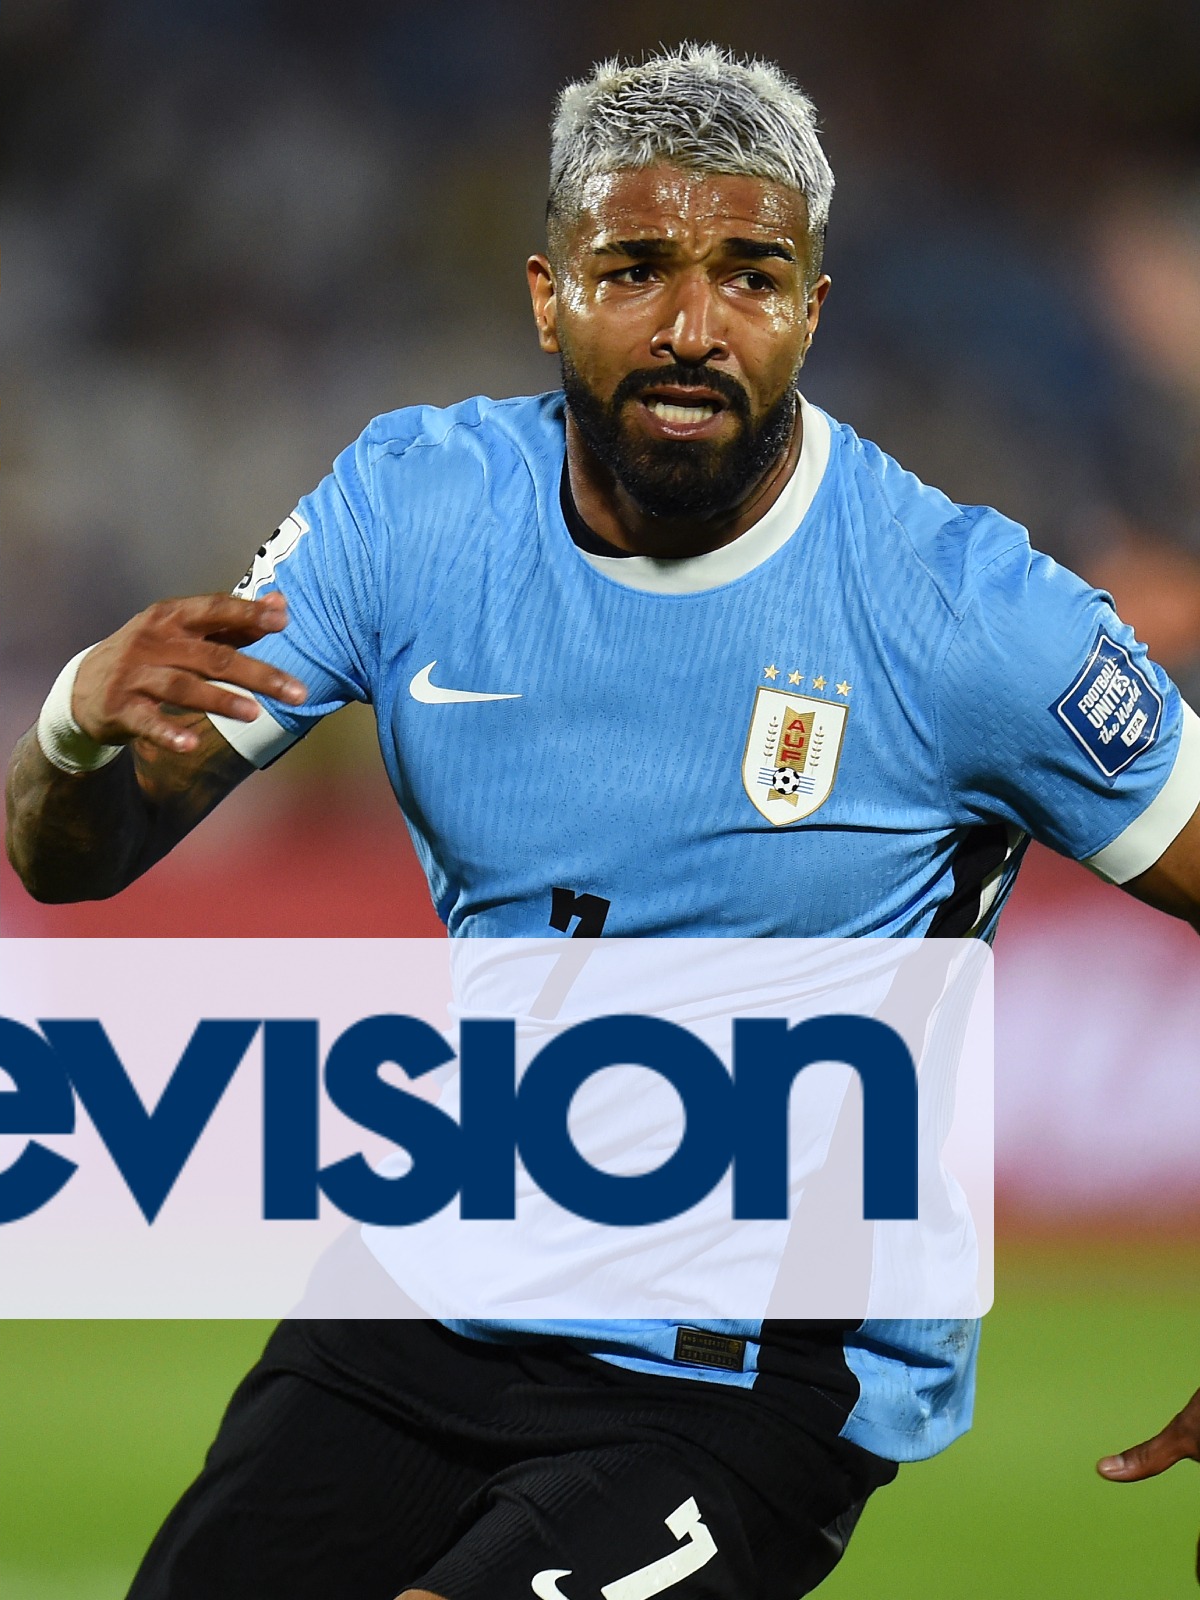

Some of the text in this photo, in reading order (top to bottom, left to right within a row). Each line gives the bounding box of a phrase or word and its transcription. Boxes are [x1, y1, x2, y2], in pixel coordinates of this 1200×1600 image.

[1077, 658, 1119, 714] FOOTBALL
[1087, 668, 1131, 729] UNITES
[1098, 722, 1120, 745] the
[1127, 717, 1143, 741] FIFA
[600, 1495, 719, 1600] 7
